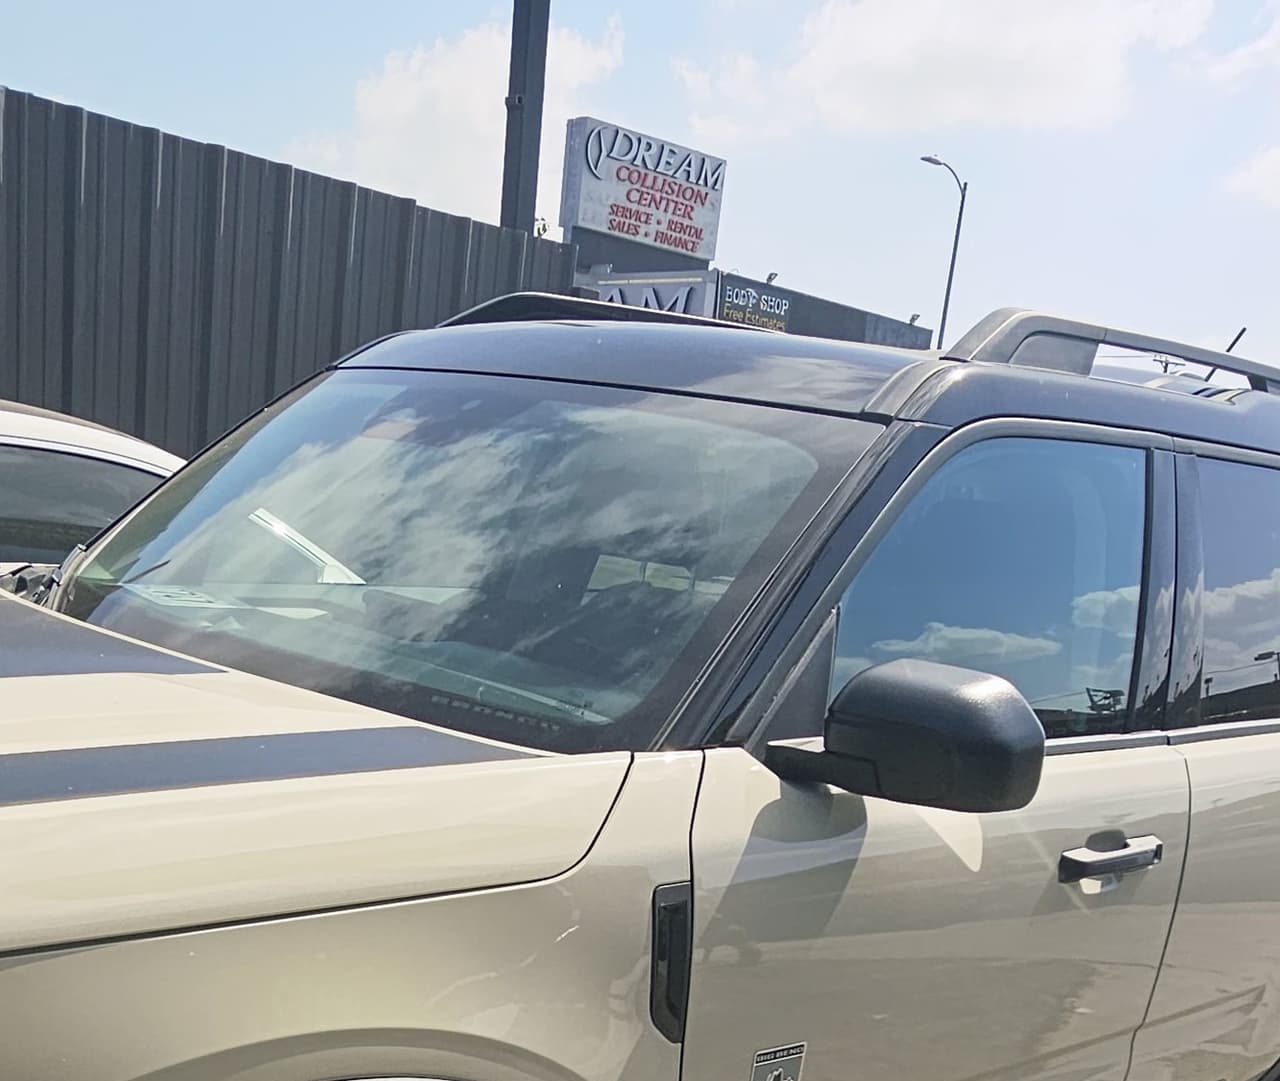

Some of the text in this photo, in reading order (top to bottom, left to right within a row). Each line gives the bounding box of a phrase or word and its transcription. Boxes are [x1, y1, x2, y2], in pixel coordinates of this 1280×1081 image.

[606, 128, 723, 191] DREAM
[616, 165, 709, 207] COLLISION
[626, 188, 695, 221] CENTER
[608, 203, 654, 226] SERVICE
[667, 219, 704, 242] RENTAL
[608, 218, 700, 253] SALES FINANCE
[726, 286, 789, 315] BODY SHOP
[723, 304, 785, 333] Free Estimates
